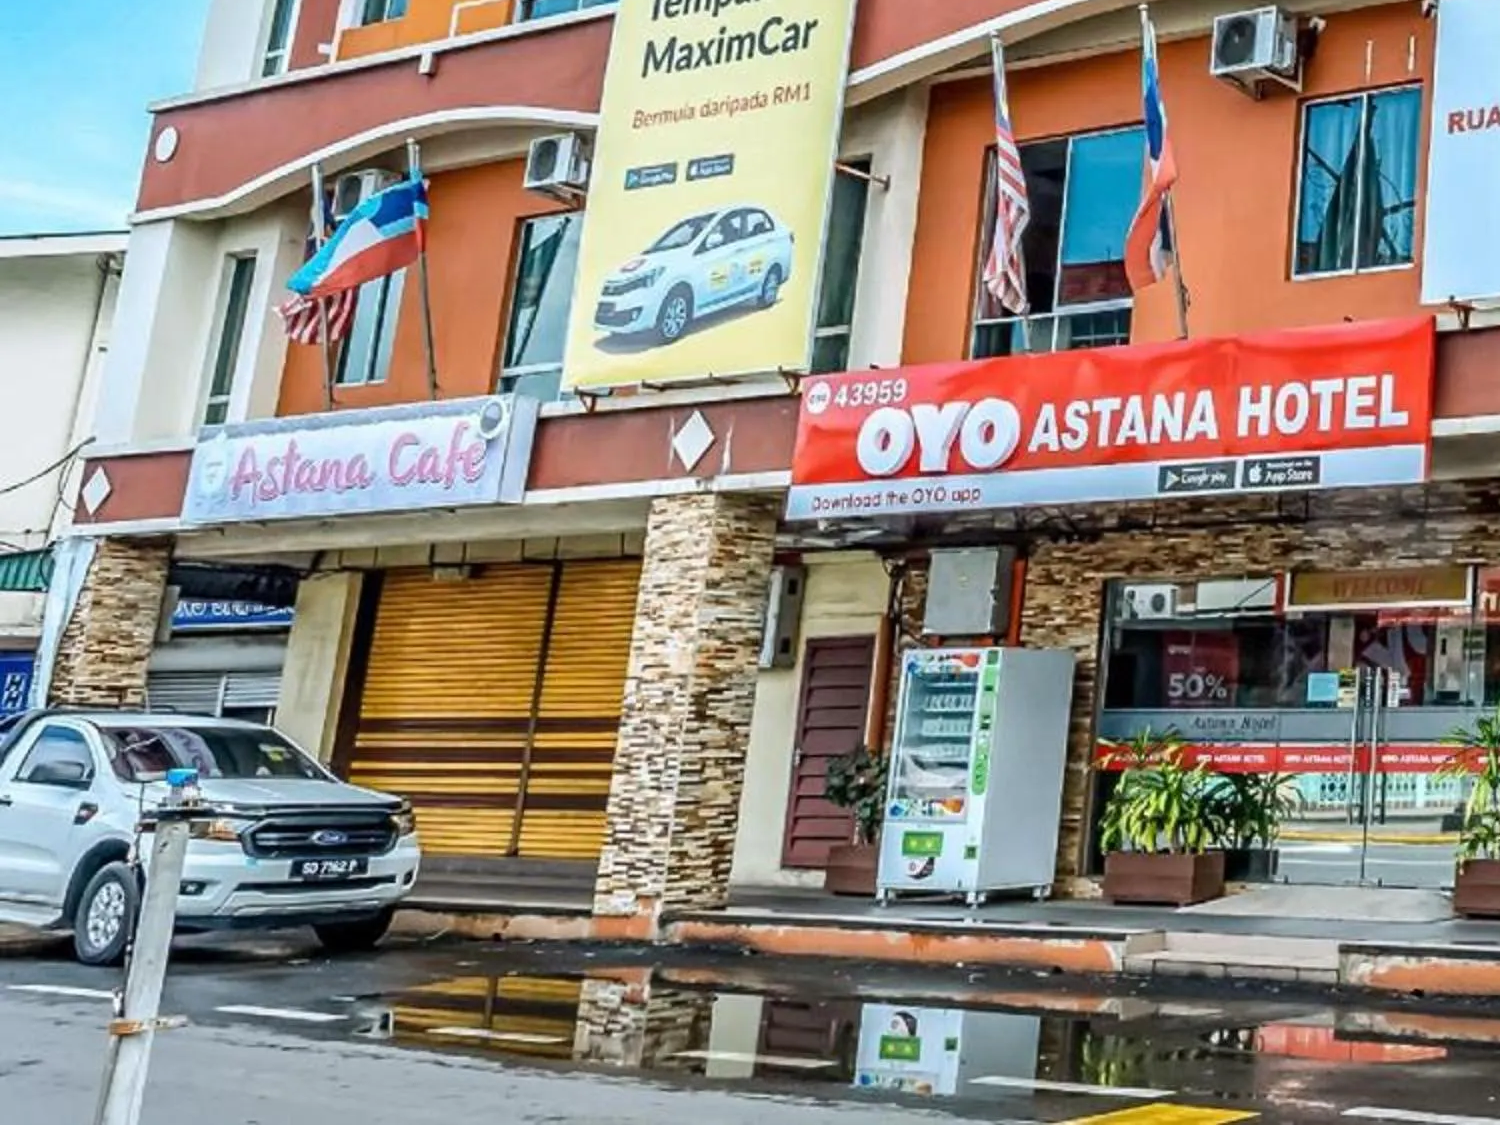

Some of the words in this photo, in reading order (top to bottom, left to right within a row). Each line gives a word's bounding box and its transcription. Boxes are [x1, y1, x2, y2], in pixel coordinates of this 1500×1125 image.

[641, 15, 819, 79] MaximCar
[632, 101, 695, 130] Bermula
[699, 91, 768, 118] daripada
[772, 82, 811, 105] RM1
[834, 378, 907, 408] 43959
[856, 396, 1022, 476] OYO
[1027, 389, 1220, 453] ASTANA
[1236, 374, 1410, 438] HOTEL
[229, 436, 377, 505] Astana
[387, 420, 487, 490] Cafe
[812, 490, 881, 510] Download
[885, 488, 908, 506] the
[911, 486, 947, 505] OYO
[951, 487, 981, 504] app
[1167, 672, 1228, 699] 50%
